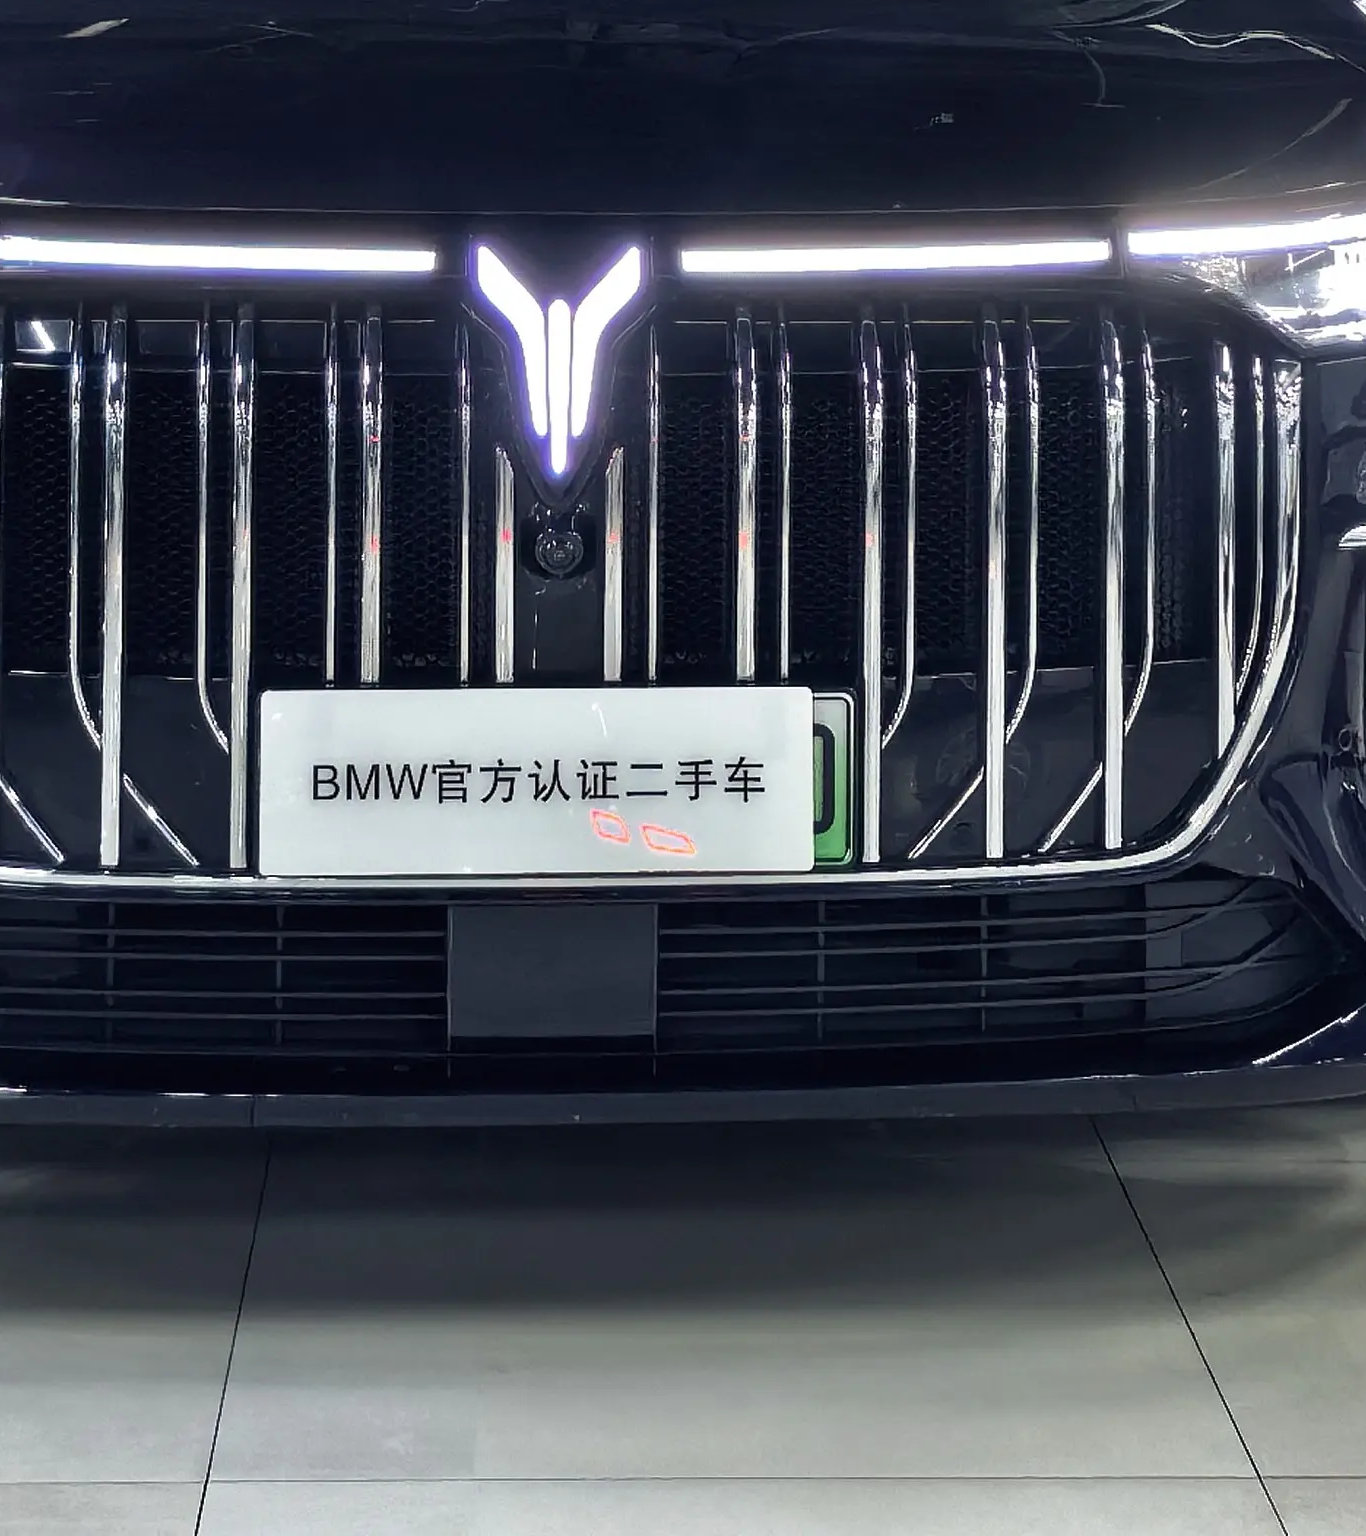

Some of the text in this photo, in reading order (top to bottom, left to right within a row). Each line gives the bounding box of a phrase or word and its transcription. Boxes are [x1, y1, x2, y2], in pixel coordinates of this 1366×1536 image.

[311, 756, 767, 804] BMW官方认证二手车
